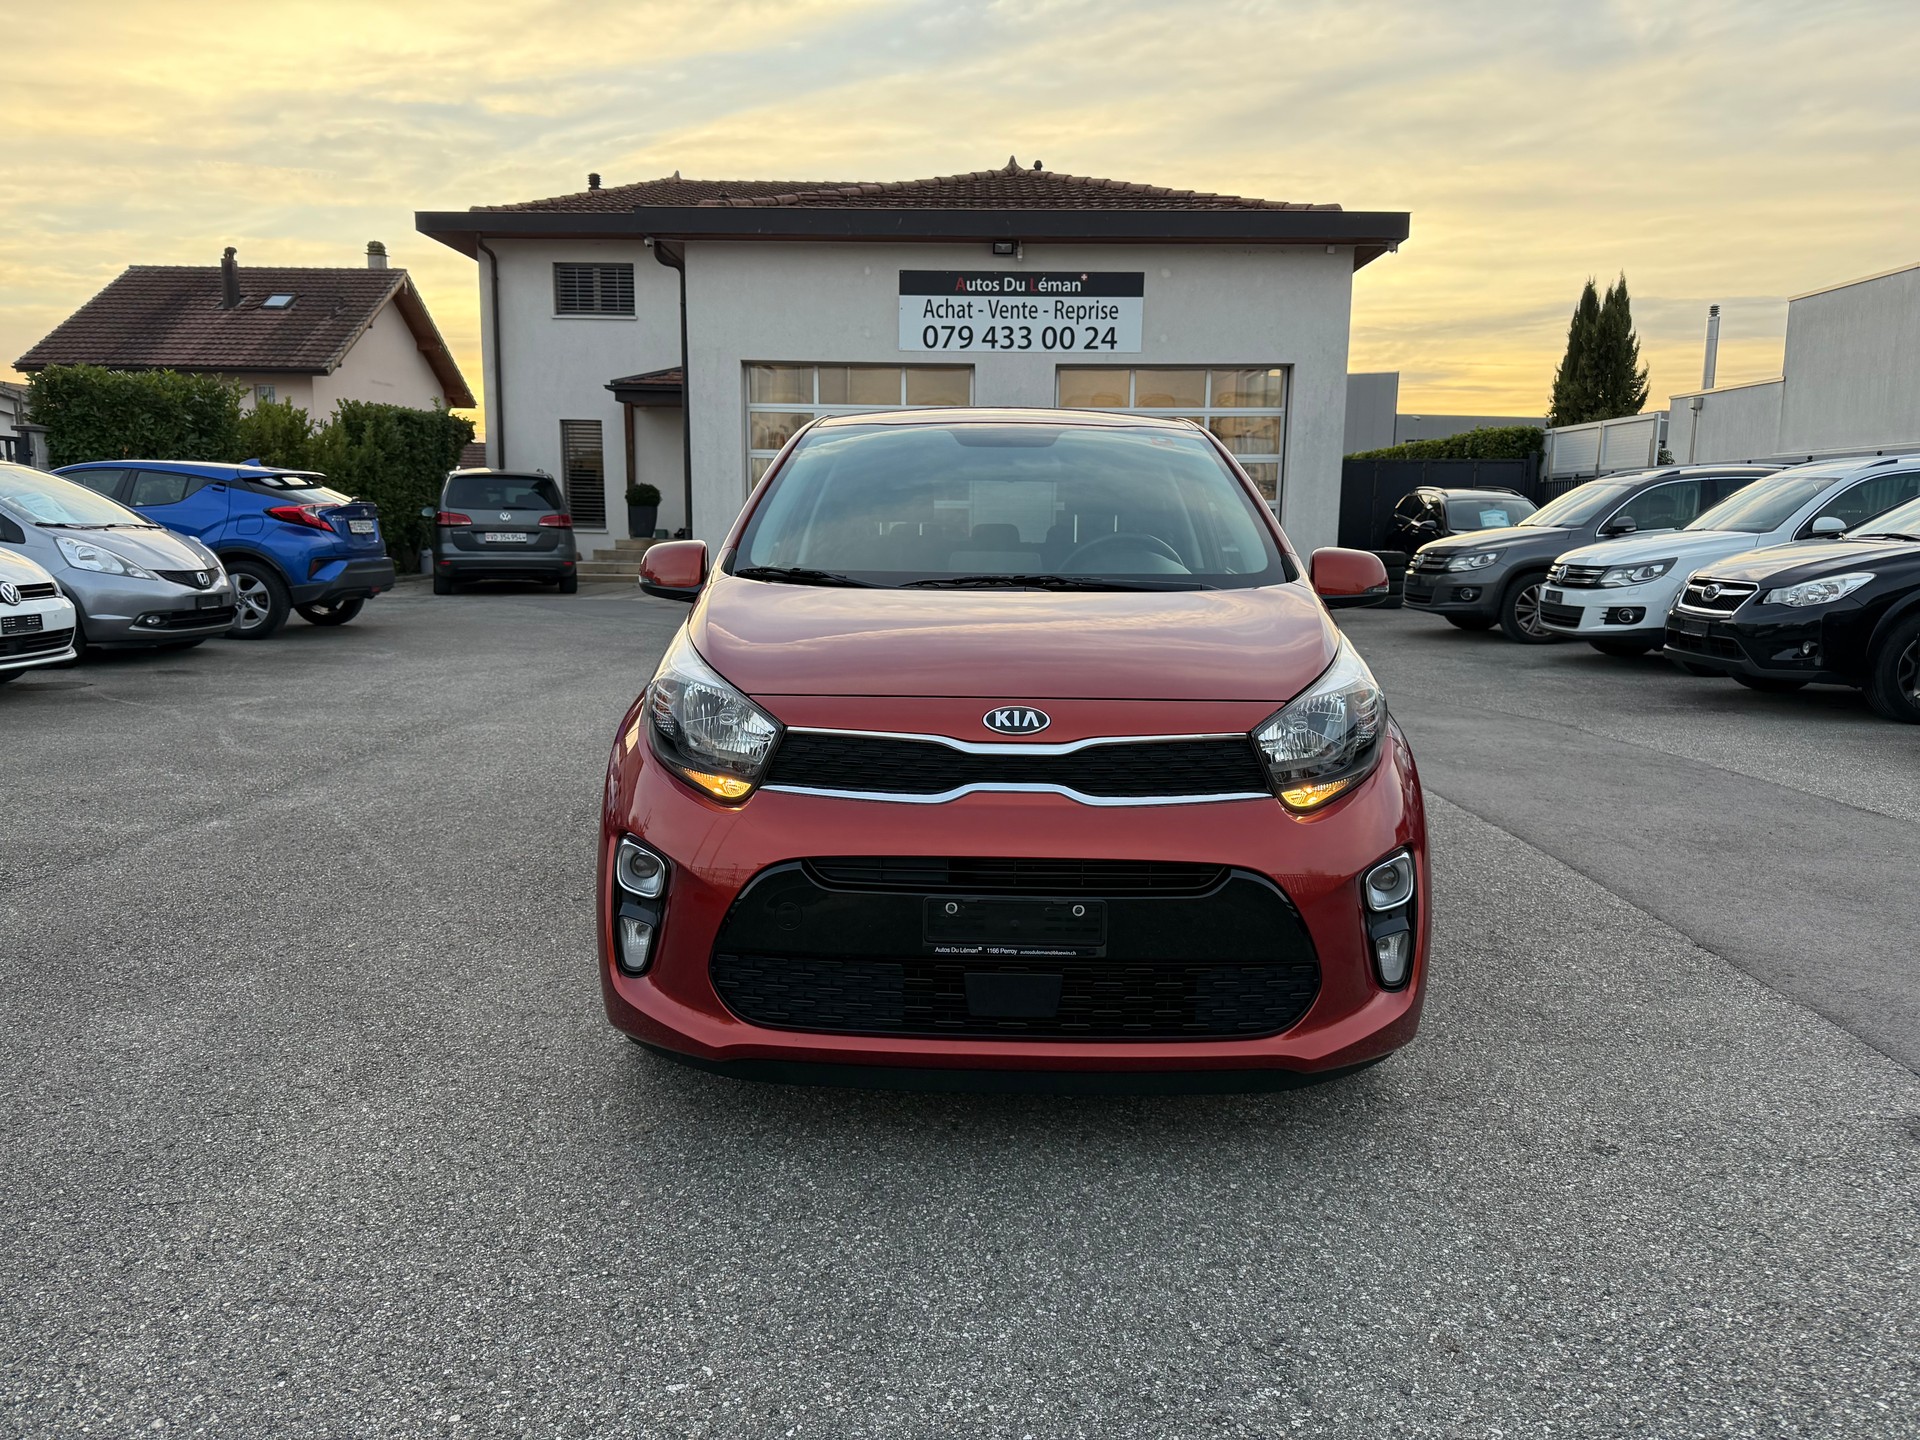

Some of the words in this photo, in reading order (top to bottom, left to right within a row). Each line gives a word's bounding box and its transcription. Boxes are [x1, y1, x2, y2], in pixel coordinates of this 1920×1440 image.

[955, 277, 1000, 292] Autos
[1003, 277, 1026, 292] Du
[1030, 277, 1082, 292] Léman
[923, 298, 974, 319] Achat
[988, 300, 1039, 320] Vente
[1054, 300, 1119, 325] Reprise
[922, 325, 974, 349] 079
[981, 326, 1032, 350] 433
[1041, 326, 1076, 350] 00
[1083, 326, 1118, 350] 24
[994, 710, 1040, 727] KIA
